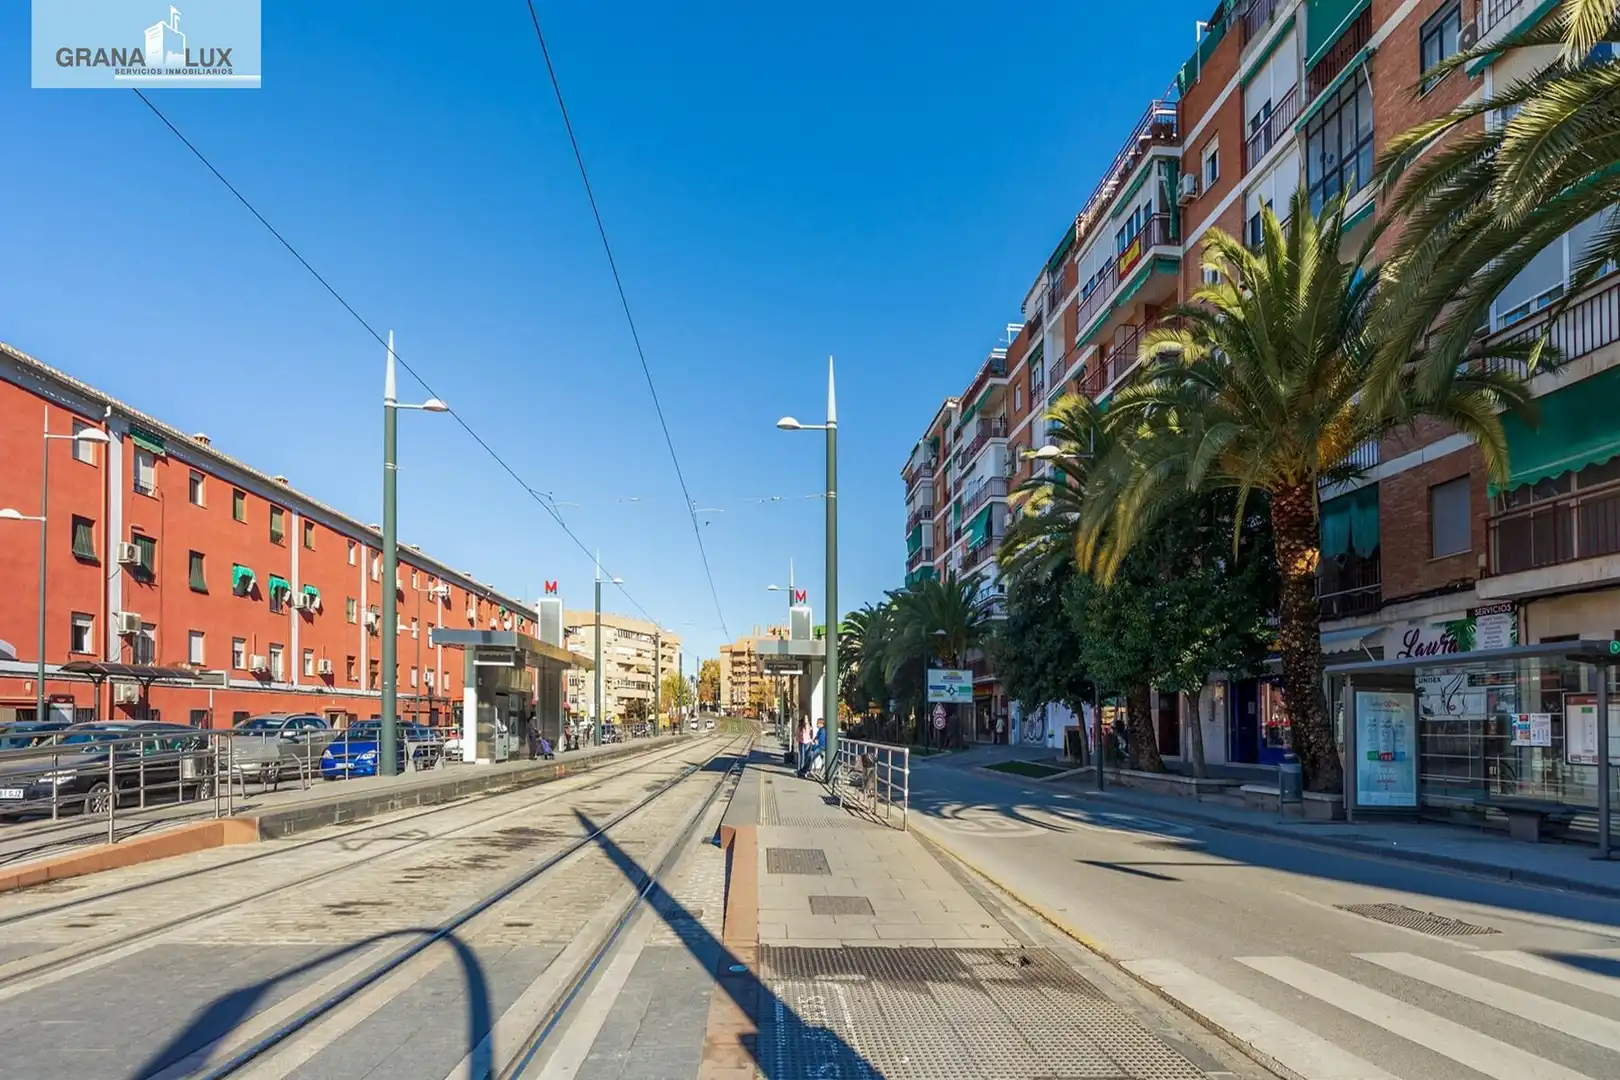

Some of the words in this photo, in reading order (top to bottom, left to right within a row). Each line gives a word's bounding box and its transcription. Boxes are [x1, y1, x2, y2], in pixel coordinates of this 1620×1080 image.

[544, 580, 557, 594] M
[795, 589, 807, 603] M
[1474, 604, 1511, 616] SERVICIOS
[1397, 628, 1458, 659] Laura
